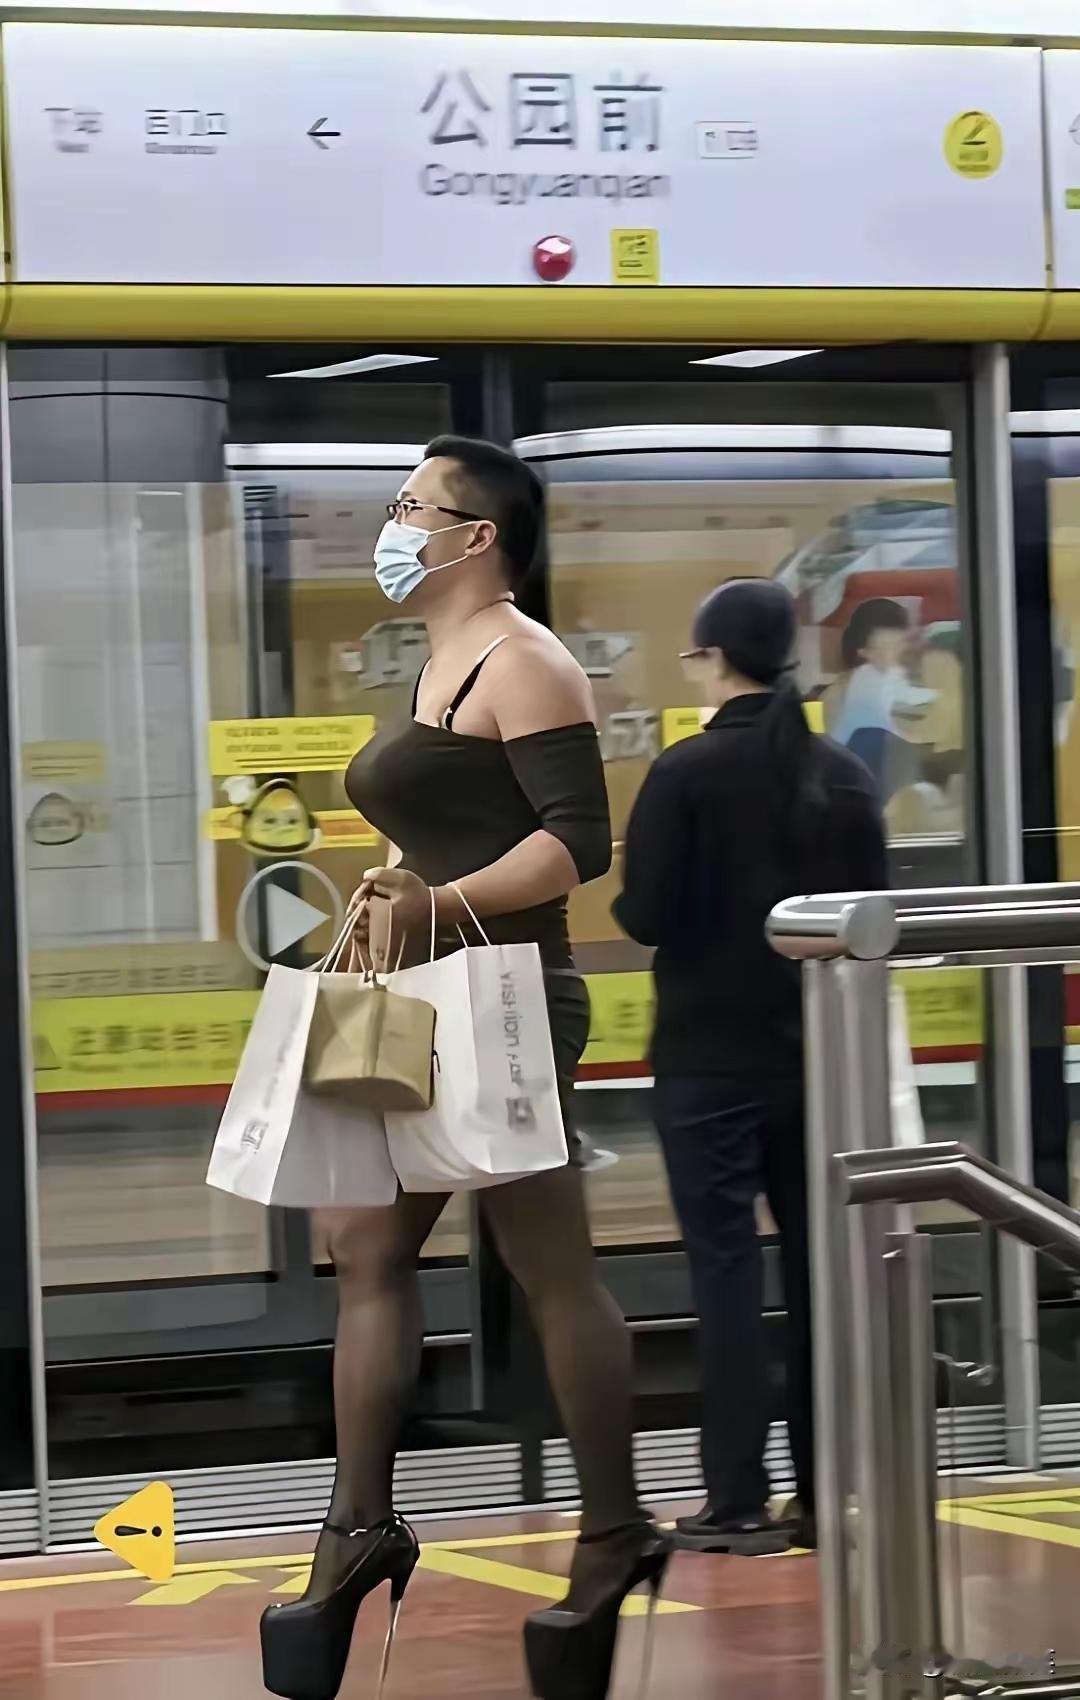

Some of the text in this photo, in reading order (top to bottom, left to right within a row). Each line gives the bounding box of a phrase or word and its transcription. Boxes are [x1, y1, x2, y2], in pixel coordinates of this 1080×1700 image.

[418, 69, 666, 150] 公园前
[419, 162, 671, 205] Gongyuanqian
